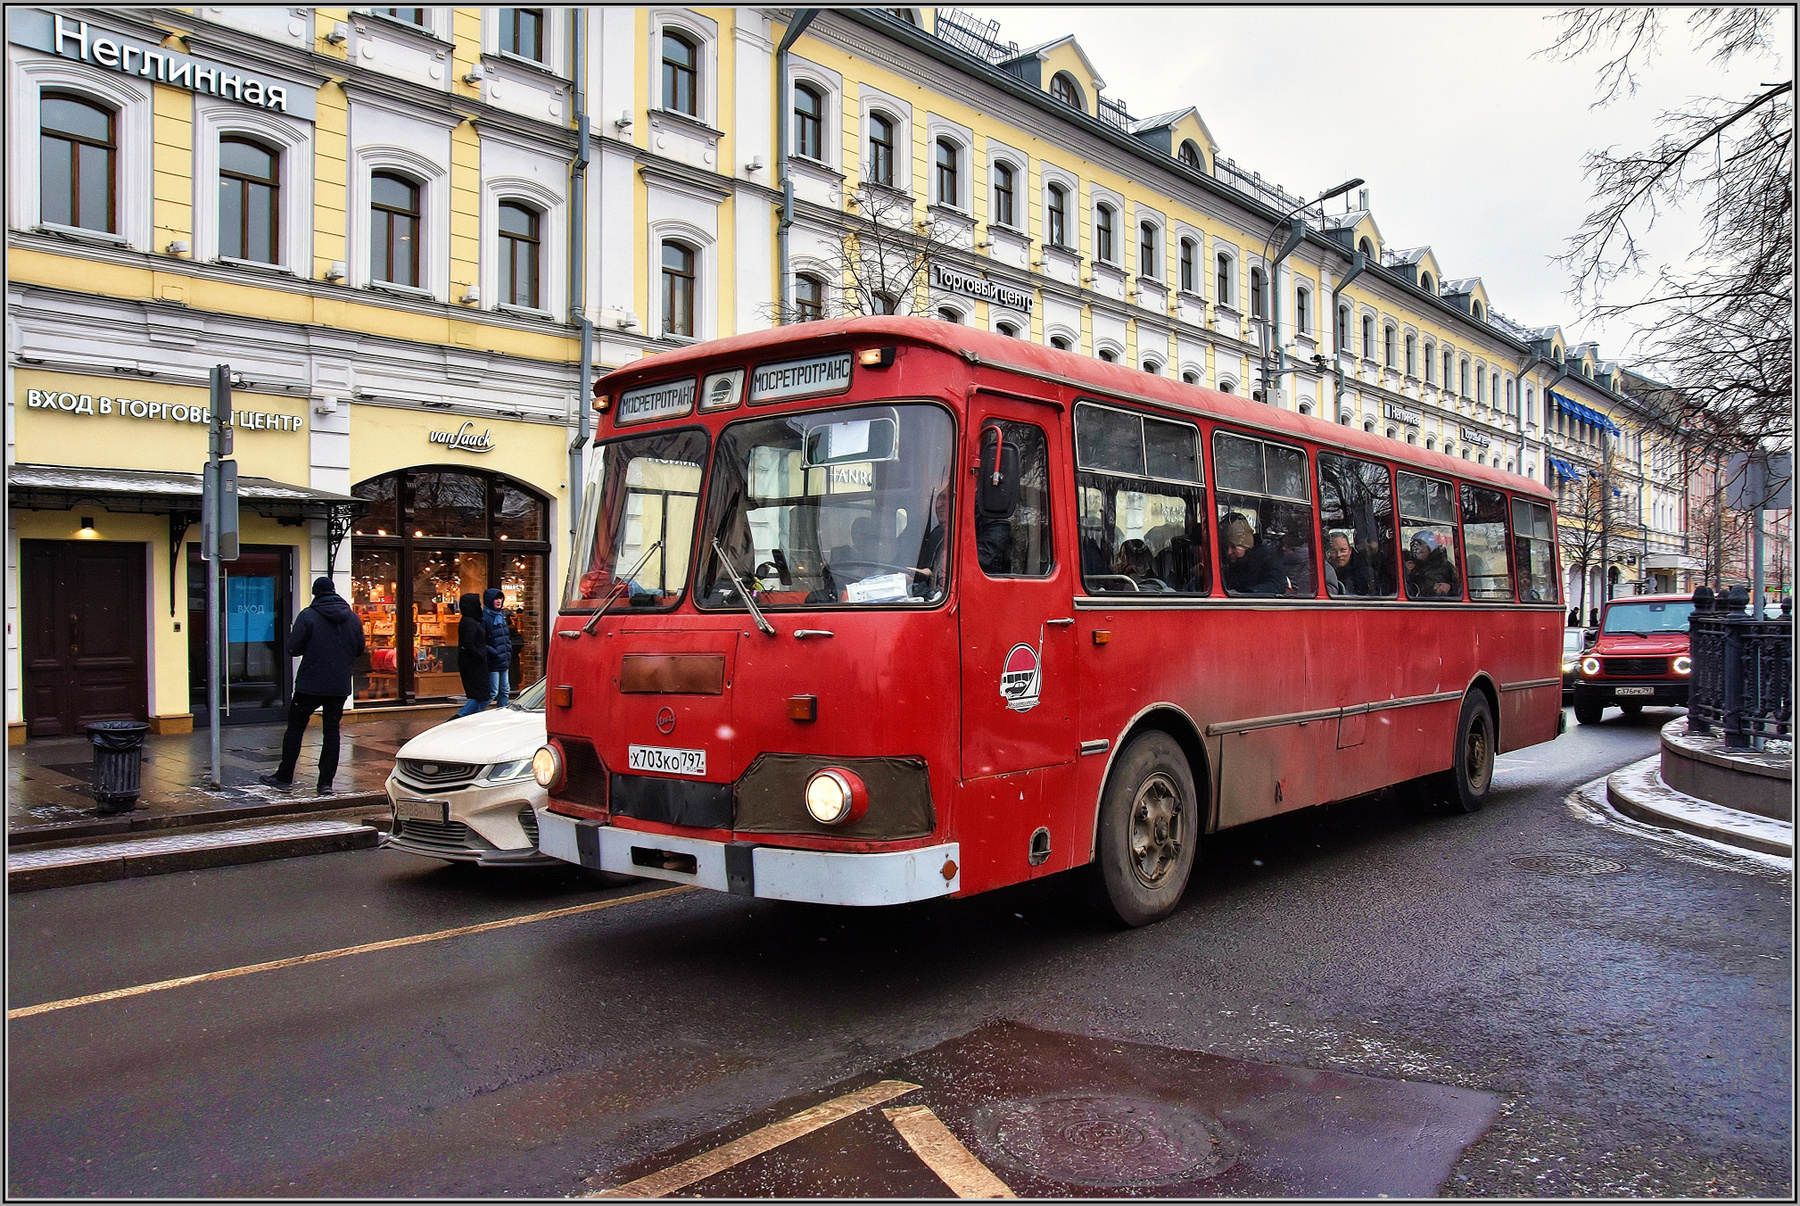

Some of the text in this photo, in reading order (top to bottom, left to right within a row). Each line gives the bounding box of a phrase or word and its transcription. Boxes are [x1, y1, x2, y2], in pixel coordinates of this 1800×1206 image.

[54, 14, 288, 112] Неглинная
[936, 264, 1035, 311] Торговый центр
[753, 358, 850, 394] МОСРЕТРОТРАНС
[26, 388, 95, 416] ВХОД
[98, 396, 113, 415] В
[239, 410, 304, 432] ЦЕНТР
[621, 384, 696, 417] МОСРЕТРОТРАНС
[429, 420, 496, 453] van Laack
[237, 604, 265, 615] ВХОД
[681, 751, 701, 769] 797
